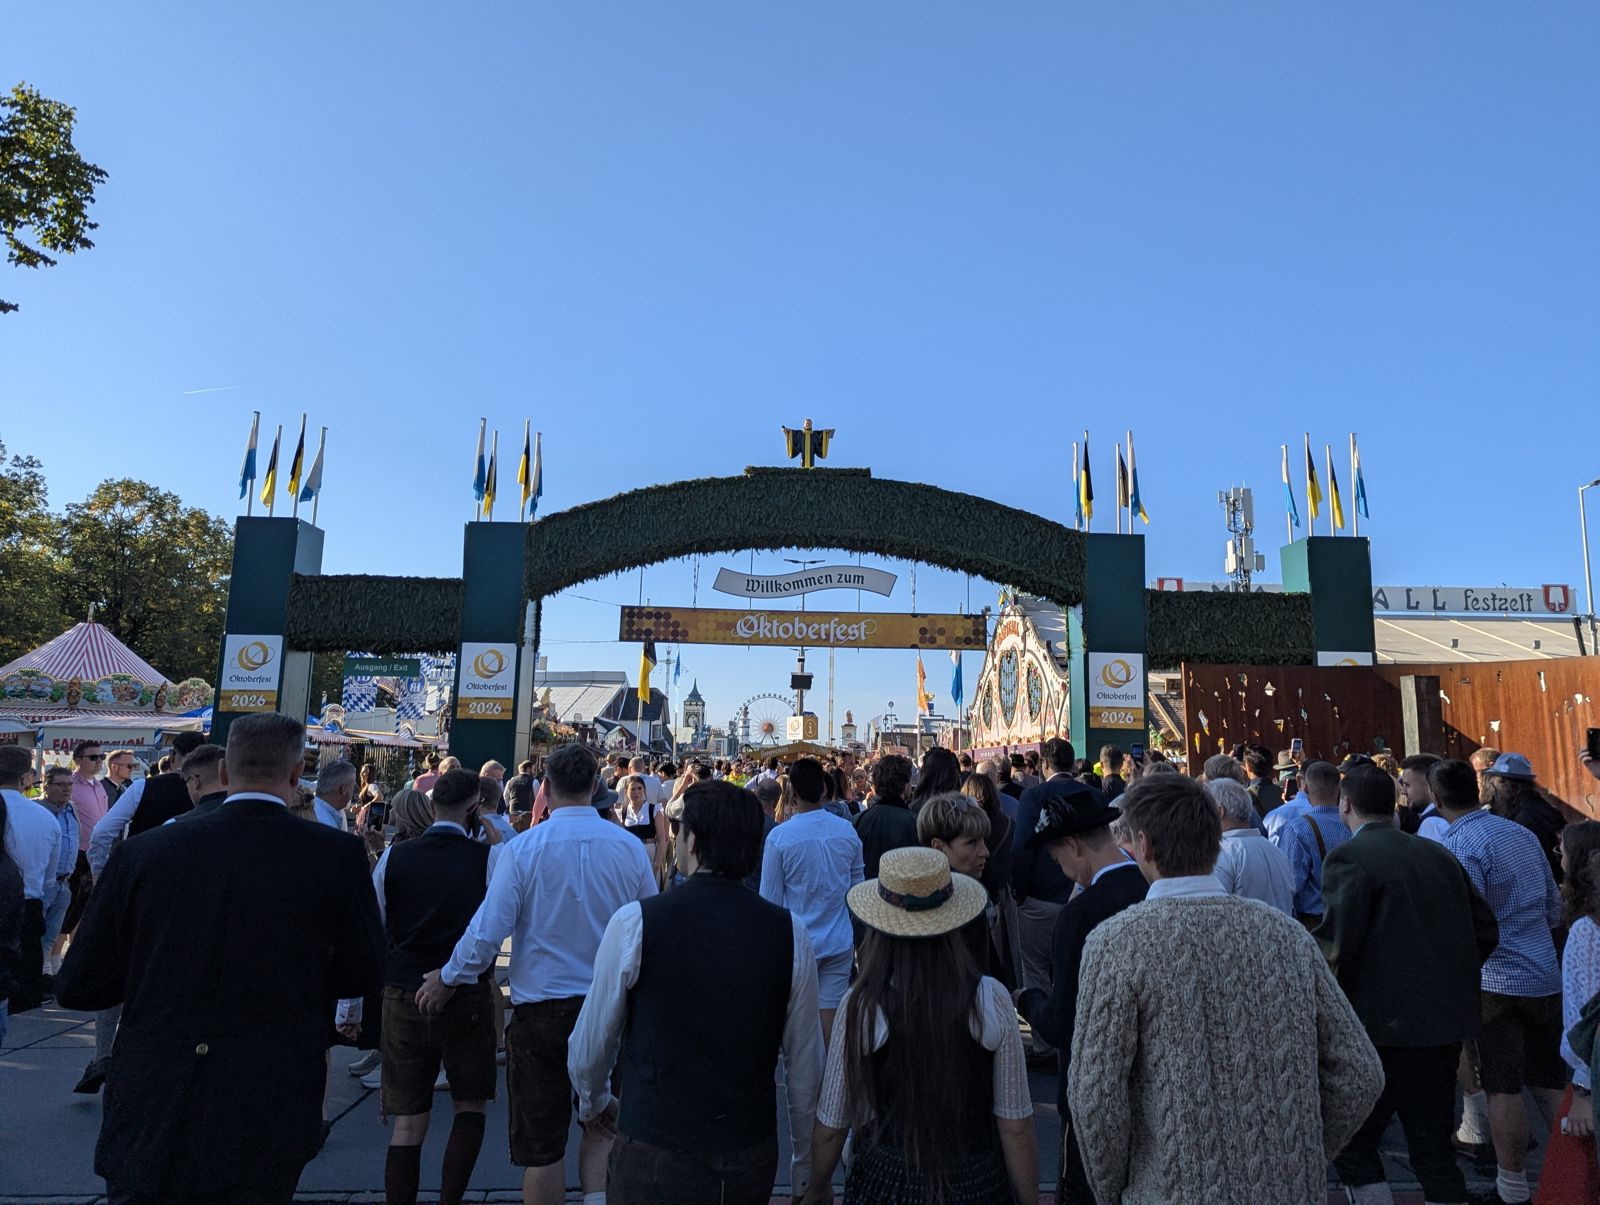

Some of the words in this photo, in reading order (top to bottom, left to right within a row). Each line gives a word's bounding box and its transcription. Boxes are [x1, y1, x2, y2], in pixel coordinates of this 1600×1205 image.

[745, 573, 833, 593] Willkommen
[836, 573, 865, 585] zum
[731, 613, 878, 644] Oktoberfest
[354, 663, 388, 672] Ausgang
[229, 674, 272, 684] Oktoberfest
[466, 682, 508, 692] Oktoberfest
[231, 694, 265, 707] 2026
[1096, 691, 1137, 701] Oktoberfest
[468, 702, 502, 714] 2026
[1101, 711, 1134, 724] 2026
